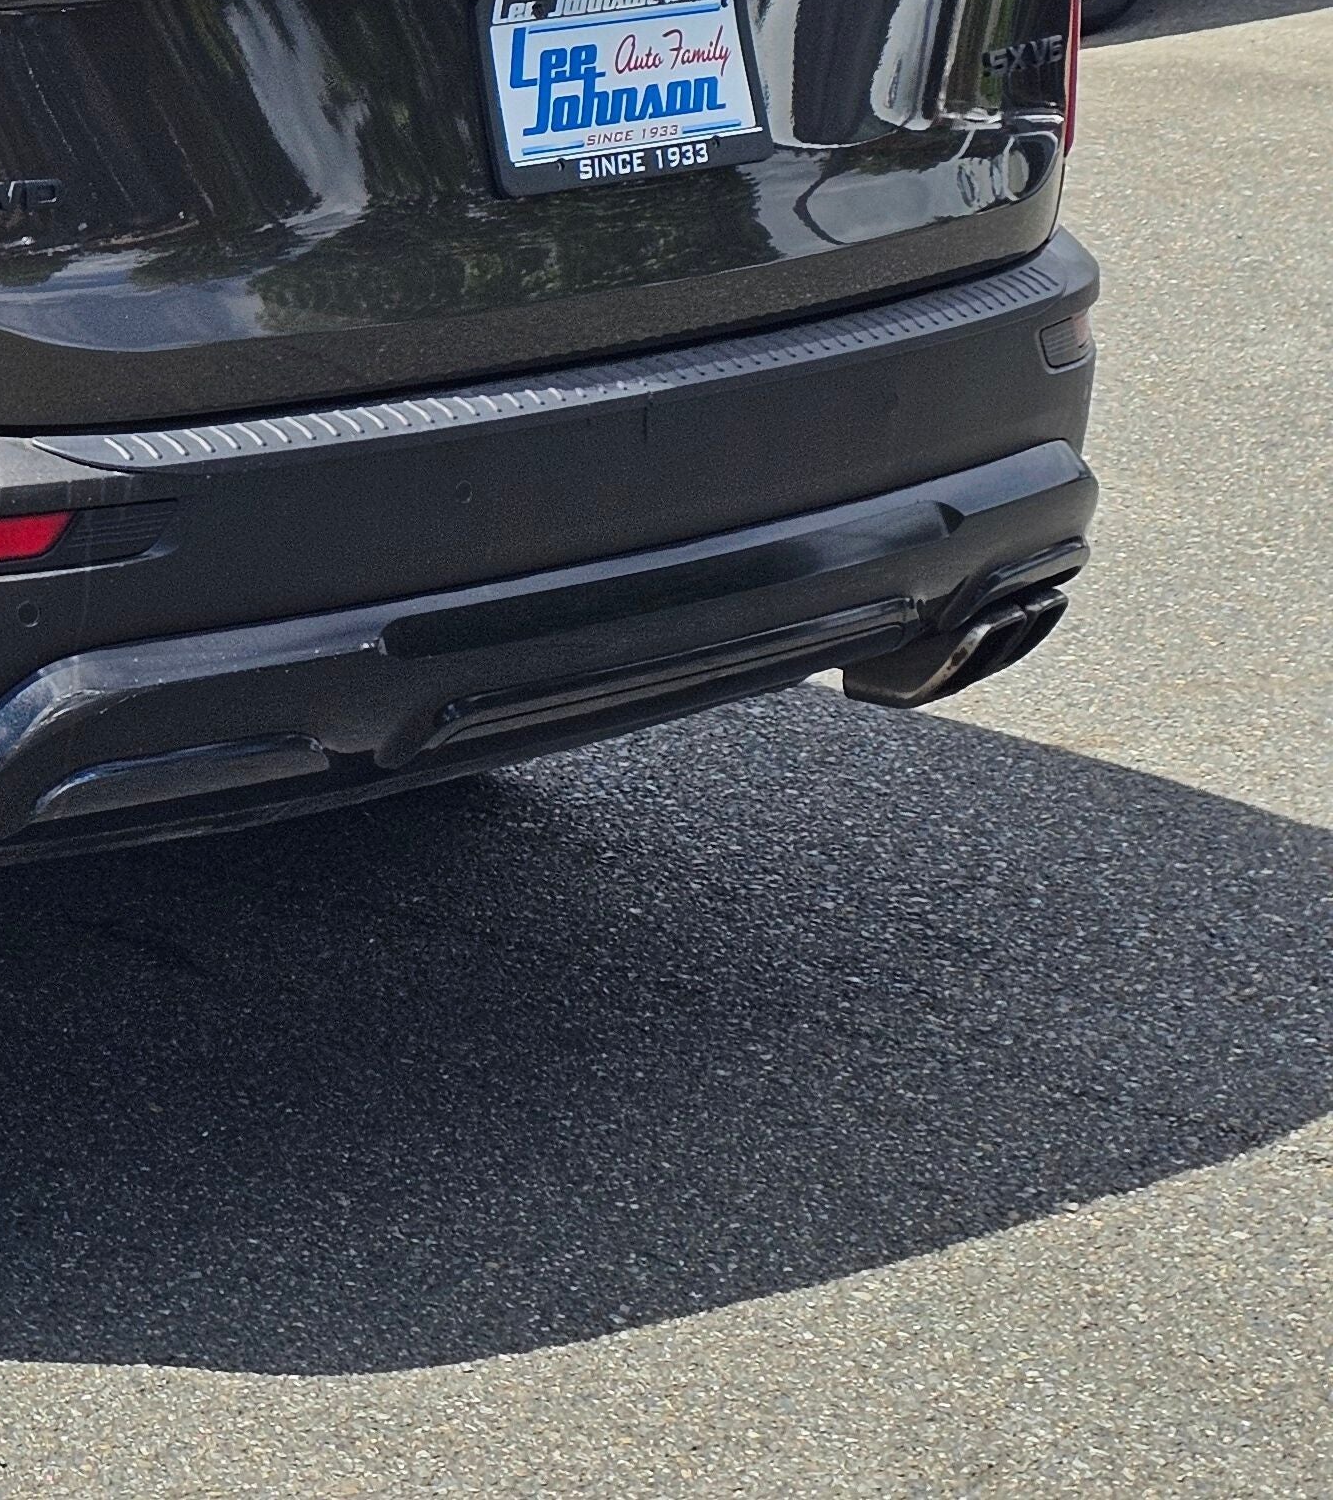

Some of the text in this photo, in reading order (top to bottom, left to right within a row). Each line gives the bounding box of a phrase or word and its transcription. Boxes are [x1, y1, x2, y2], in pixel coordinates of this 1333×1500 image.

[510, 25, 731, 88] Lee Auto Family
[523, 66, 726, 137] Johnson
[586, 124, 679, 147] SINCE 1933
[579, 142, 709, 180] SINCE 1933
